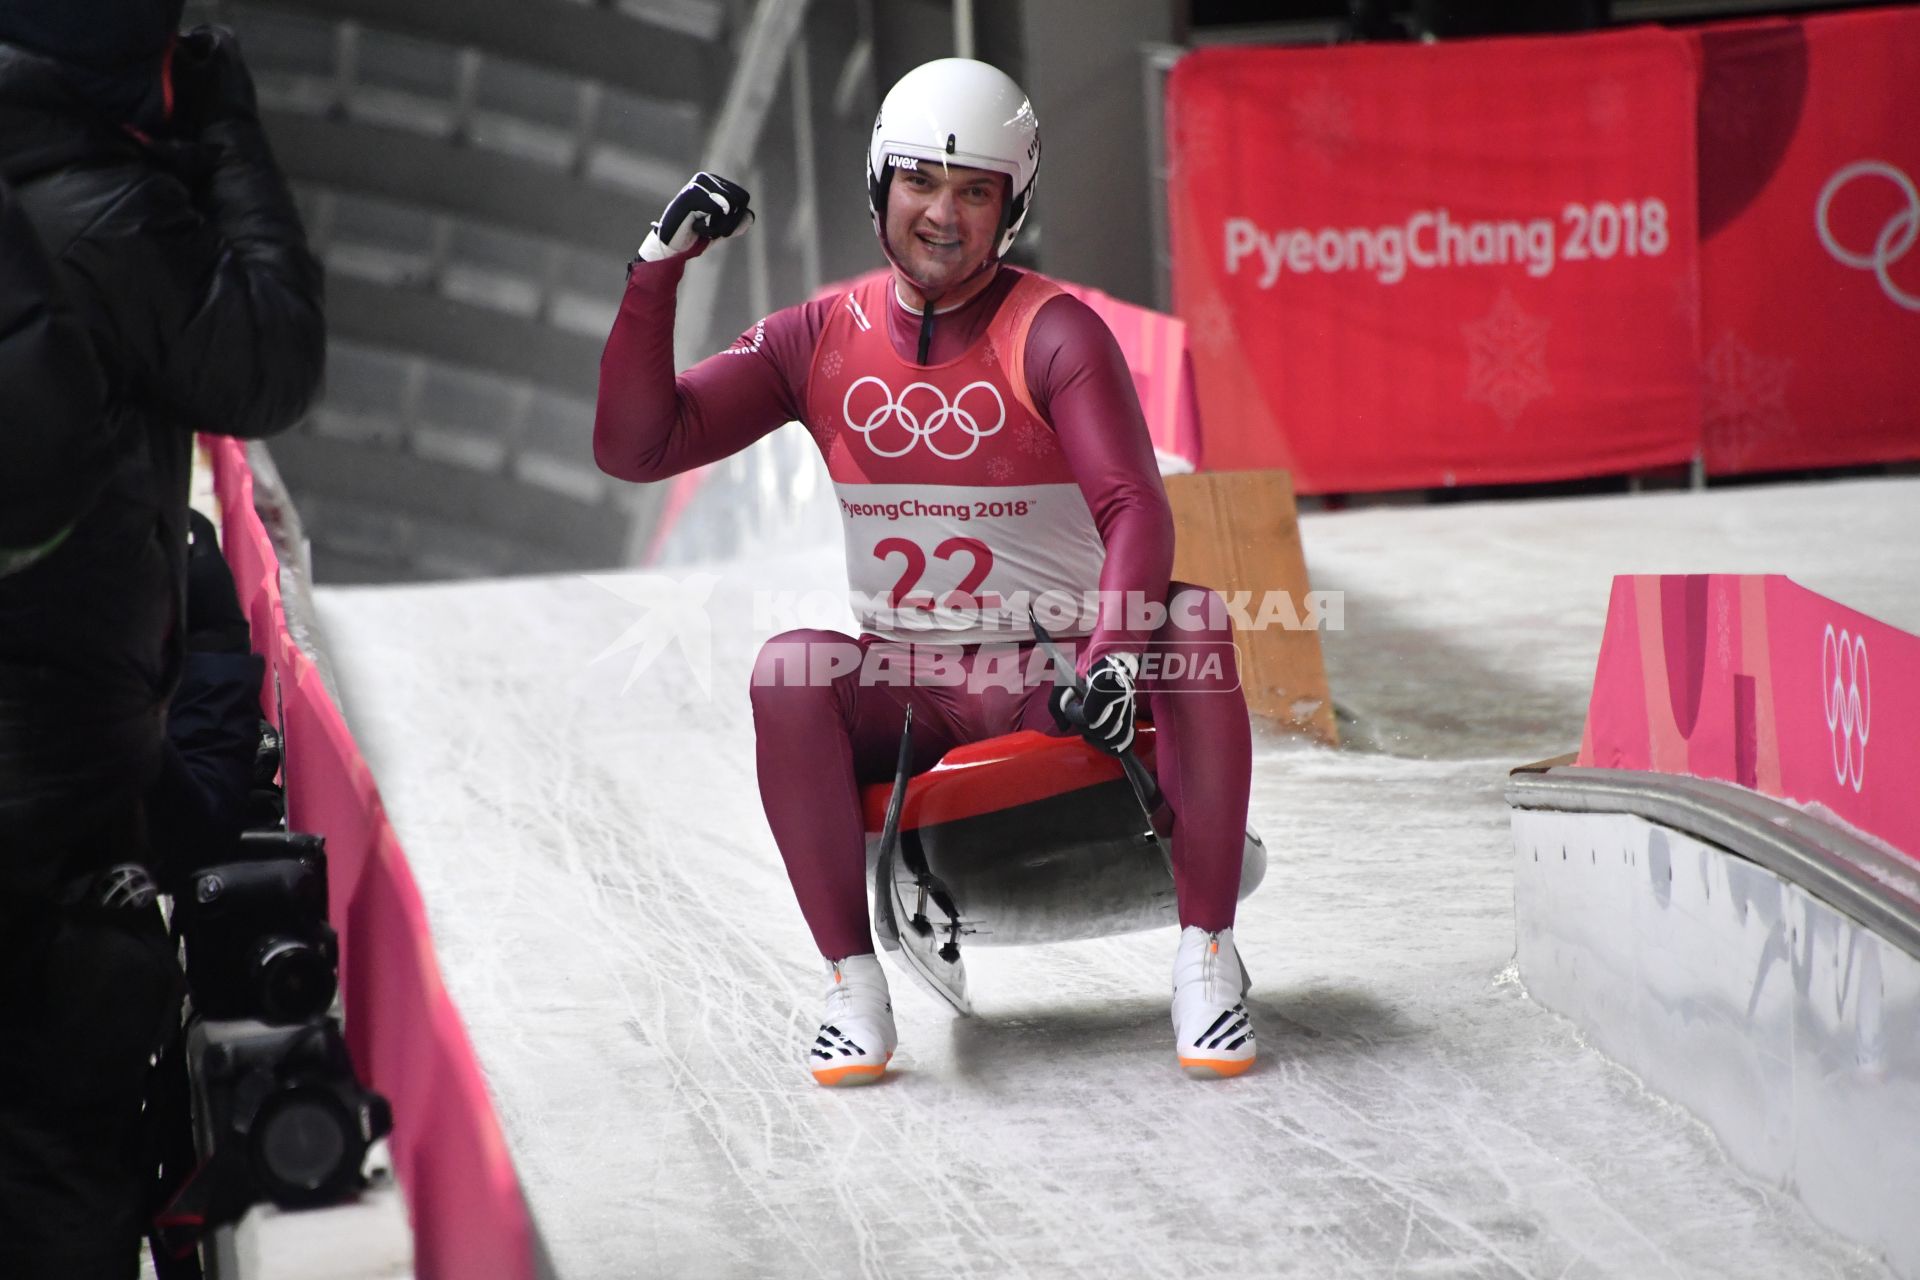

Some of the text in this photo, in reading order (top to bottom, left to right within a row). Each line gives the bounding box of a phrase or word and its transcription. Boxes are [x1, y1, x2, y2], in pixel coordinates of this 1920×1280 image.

[888, 154, 918, 171] uvex
[1224, 197, 1668, 289] PyeongChang 2018
[841, 498, 1029, 521] PyeongChang 2018
[873, 537, 1002, 609] 22
